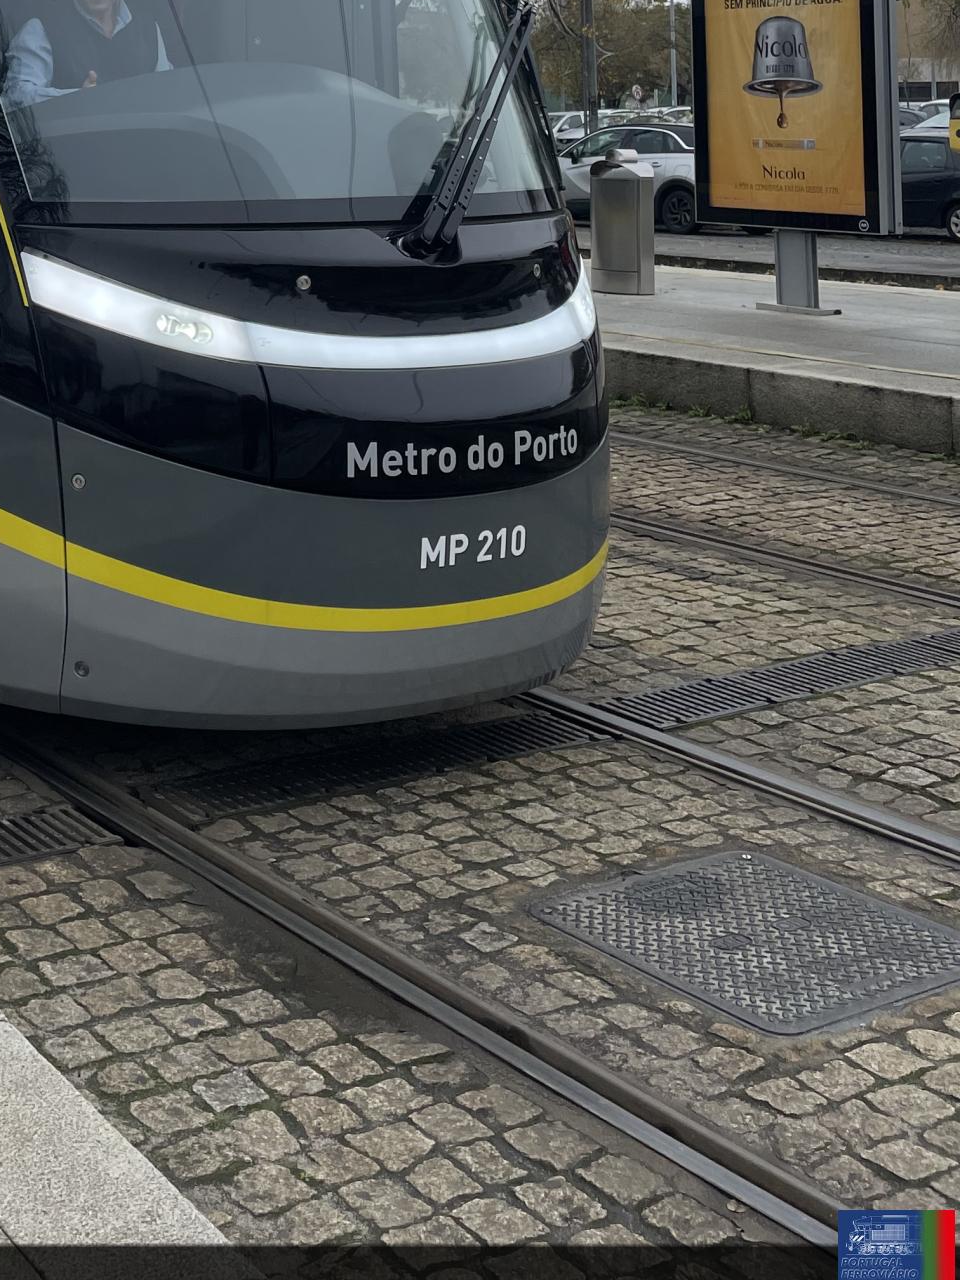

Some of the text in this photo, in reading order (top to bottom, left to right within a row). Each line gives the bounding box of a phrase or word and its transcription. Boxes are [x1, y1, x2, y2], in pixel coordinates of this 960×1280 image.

[756, 34, 807, 59] Nicola
[762, 164, 806, 180] Nicola
[346, 425, 578, 478] Metro do Porto
[420, 525, 526, 569] MP 210
